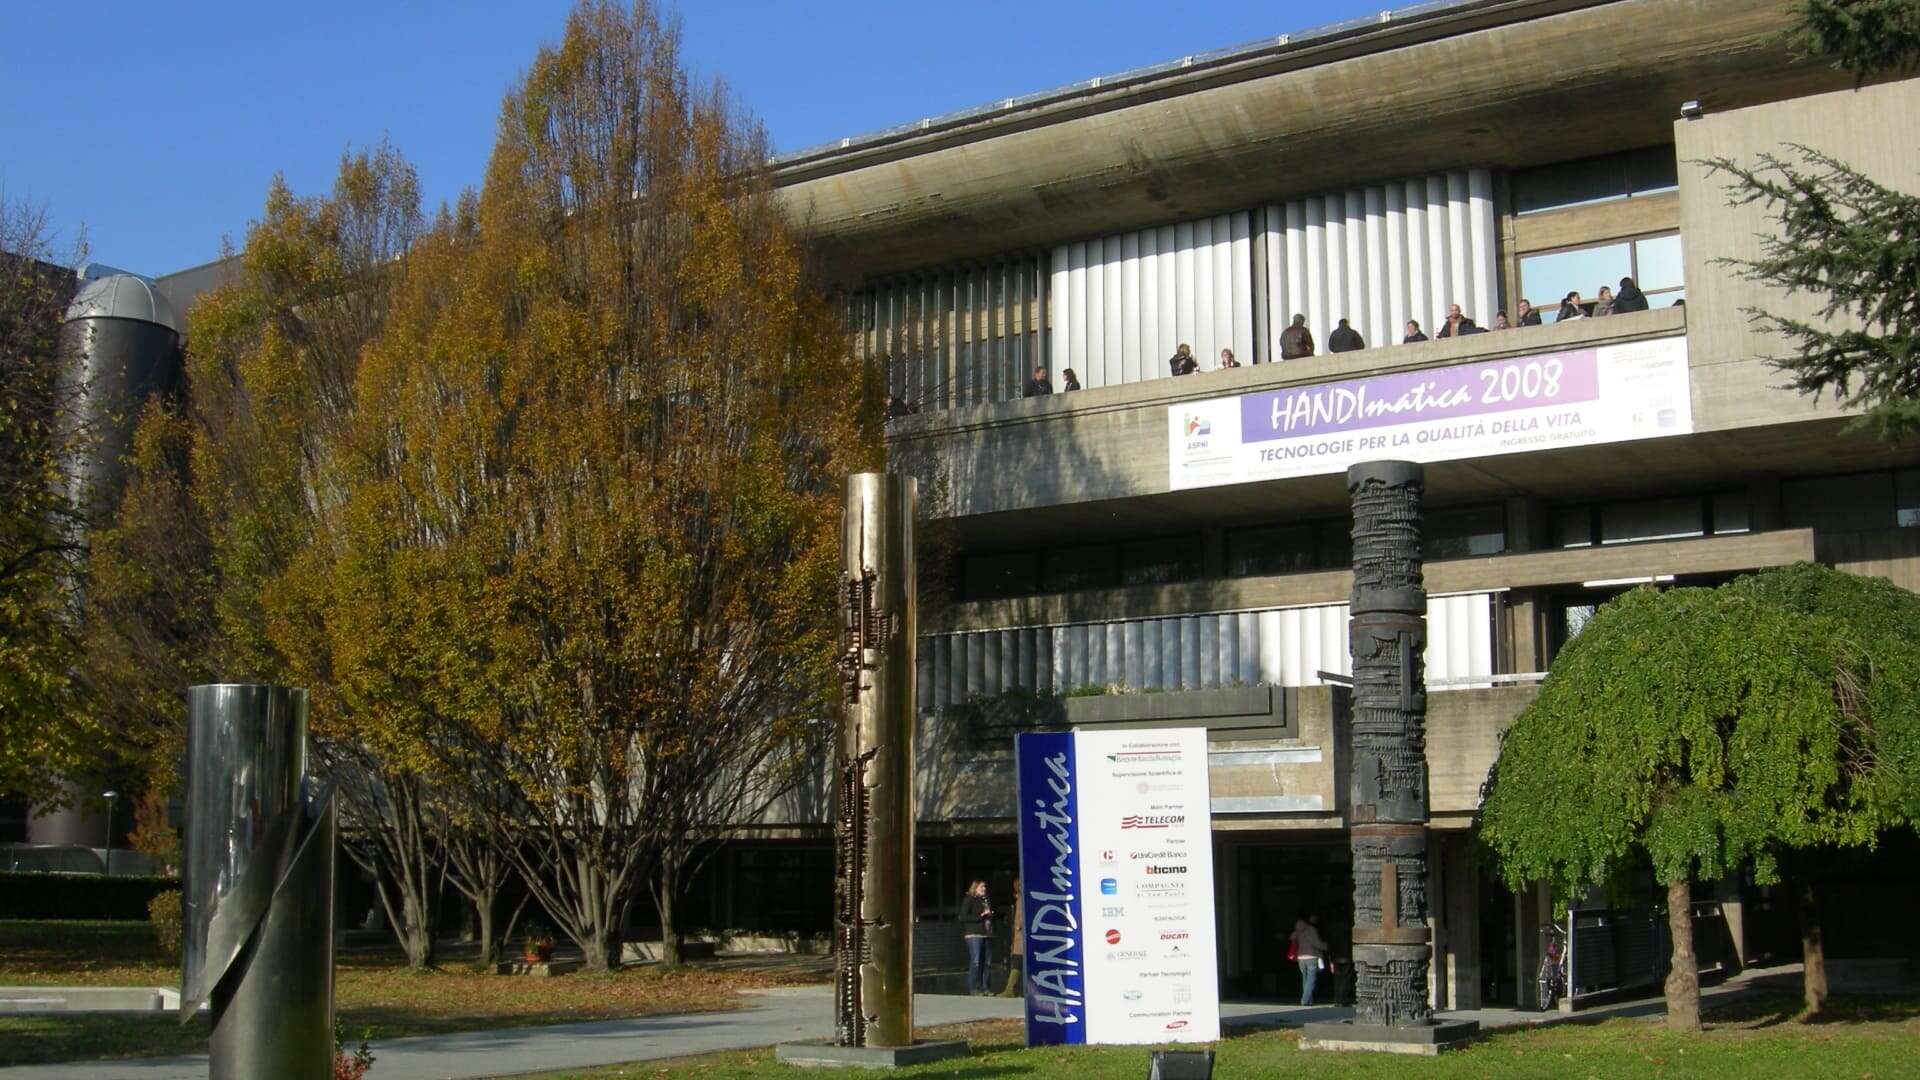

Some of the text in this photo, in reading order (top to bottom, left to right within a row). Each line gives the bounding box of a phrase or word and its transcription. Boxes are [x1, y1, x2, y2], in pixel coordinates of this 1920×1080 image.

[1271, 358, 1564, 433] HANDImatica 2008
[1260, 439, 1353, 463] TECNOLOGIE
[1359, 435, 1387, 451] PER
[1392, 432, 1410, 446] LA
[1491, 417, 1539, 435] DELLA
[1546, 412, 1582, 427] VITA
[1500, 435, 1547, 447] INGRESSO
[1550, 428, 1596, 441] GRATUITO
[1144, 815, 1185, 824] TELECOM
[1137, 850, 1187, 859] UniCredit Banca
[1146, 865, 1187, 874] bticino
[1030, 752, 1082, 1025] HANDImatica
[1102, 906, 1124, 918] IBM
[1160, 933, 1189, 941] DUCATI
